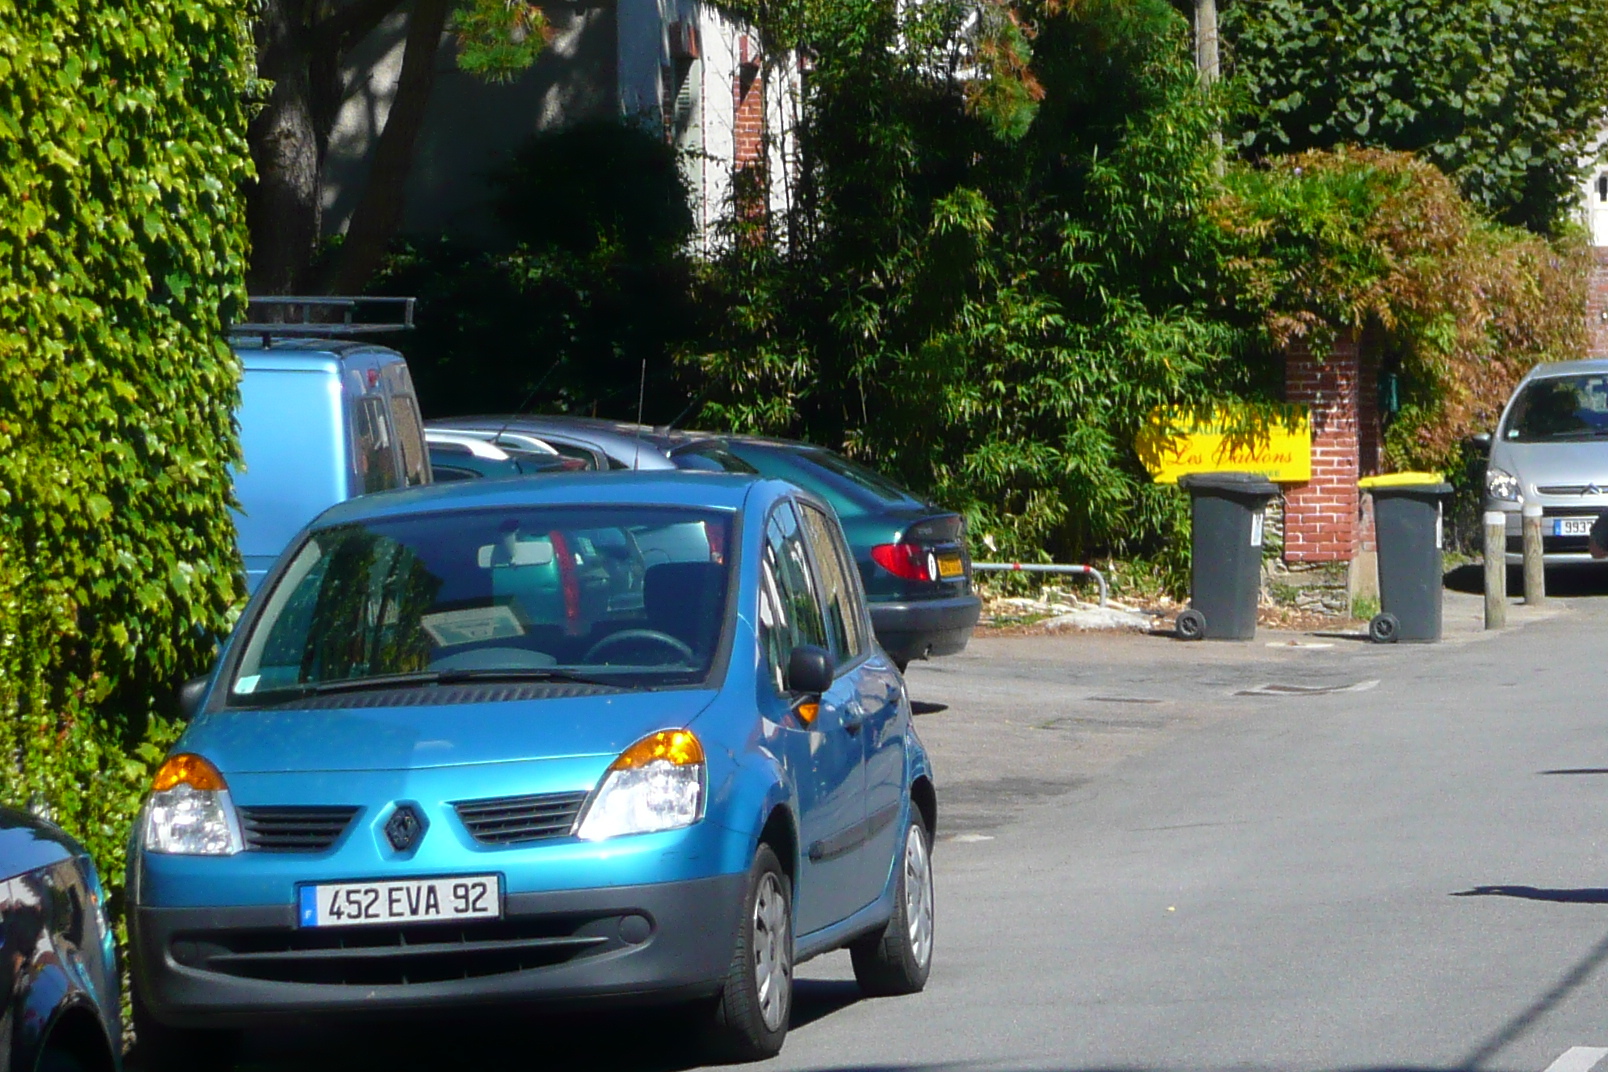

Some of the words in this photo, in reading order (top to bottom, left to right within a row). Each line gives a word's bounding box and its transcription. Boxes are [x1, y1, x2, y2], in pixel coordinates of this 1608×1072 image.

[1166, 438, 1203, 466] Les
[328, 888, 381, 920] 452
[387, 884, 441, 917] EVA
[452, 882, 489, 914] 92
